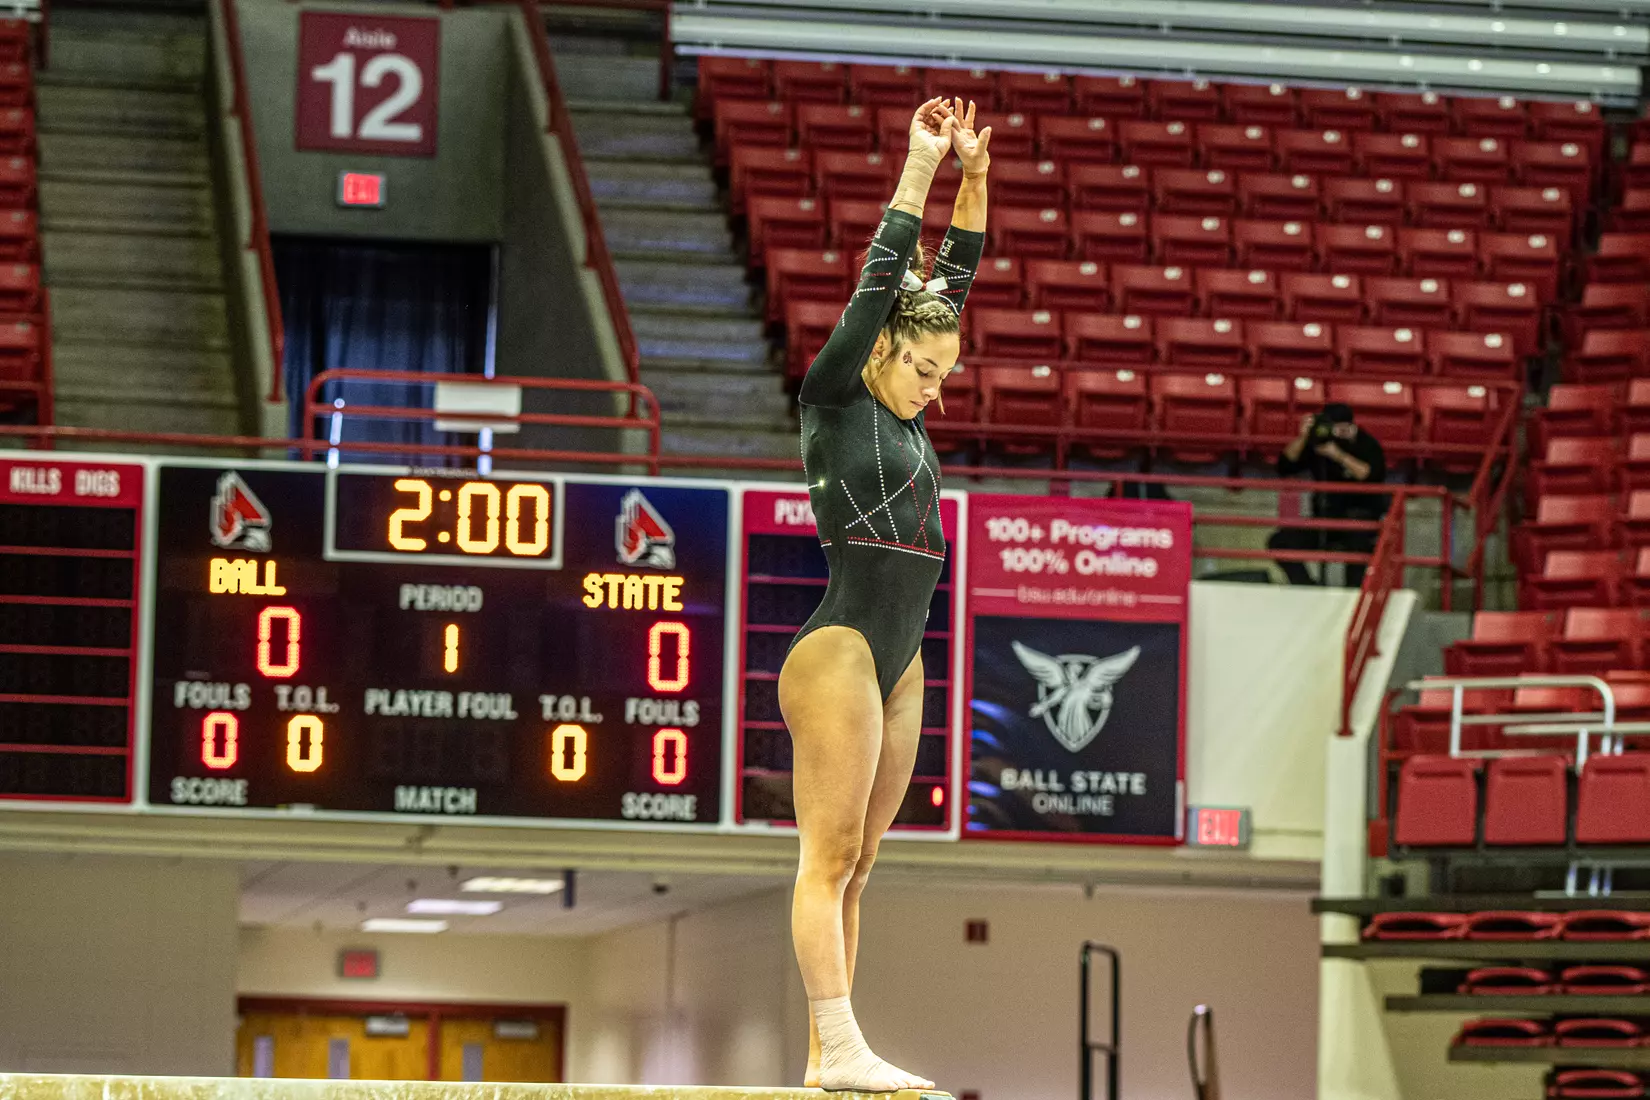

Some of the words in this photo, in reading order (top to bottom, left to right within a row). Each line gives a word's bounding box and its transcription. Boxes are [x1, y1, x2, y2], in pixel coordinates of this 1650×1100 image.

[311, 52, 423, 143] 12
[10, 467, 61, 494] KILLS
[75, 470, 120, 496] DIGS
[388, 479, 550, 556] 2:00
[986, 517, 1045, 543] 100+
[1050, 518, 1174, 550] Programs
[209, 558, 286, 596] BALL
[1000, 547, 1070, 575] 100%
[1074, 549, 1158, 578] Online
[400, 584, 483, 612] PERIOD
[582, 573, 684, 611] STATE
[257, 606, 300, 677] 0
[444, 624, 459, 673] 1
[648, 621, 690, 692] 0
[174, 682, 251, 710] FOULS
[274, 685, 340, 713] T.O.L.
[364, 688, 452, 716] PLAYER
[457, 692, 518, 719] FOUL
[539, 694, 603, 723] T.O.L.
[625, 698, 700, 727] FOULS
[202, 711, 239, 769] 0
[286, 714, 324, 772] 0
[551, 724, 587, 782] 0
[652, 728, 688, 785] 0
[171, 776, 248, 805] SCORE
[1000, 768, 1064, 792] BALL
[1070, 770, 1147, 795] STATE
[394, 785, 478, 814] MATCH
[621, 793, 698, 821] SCORE
[1031, 793, 1114, 816] ONLINE
